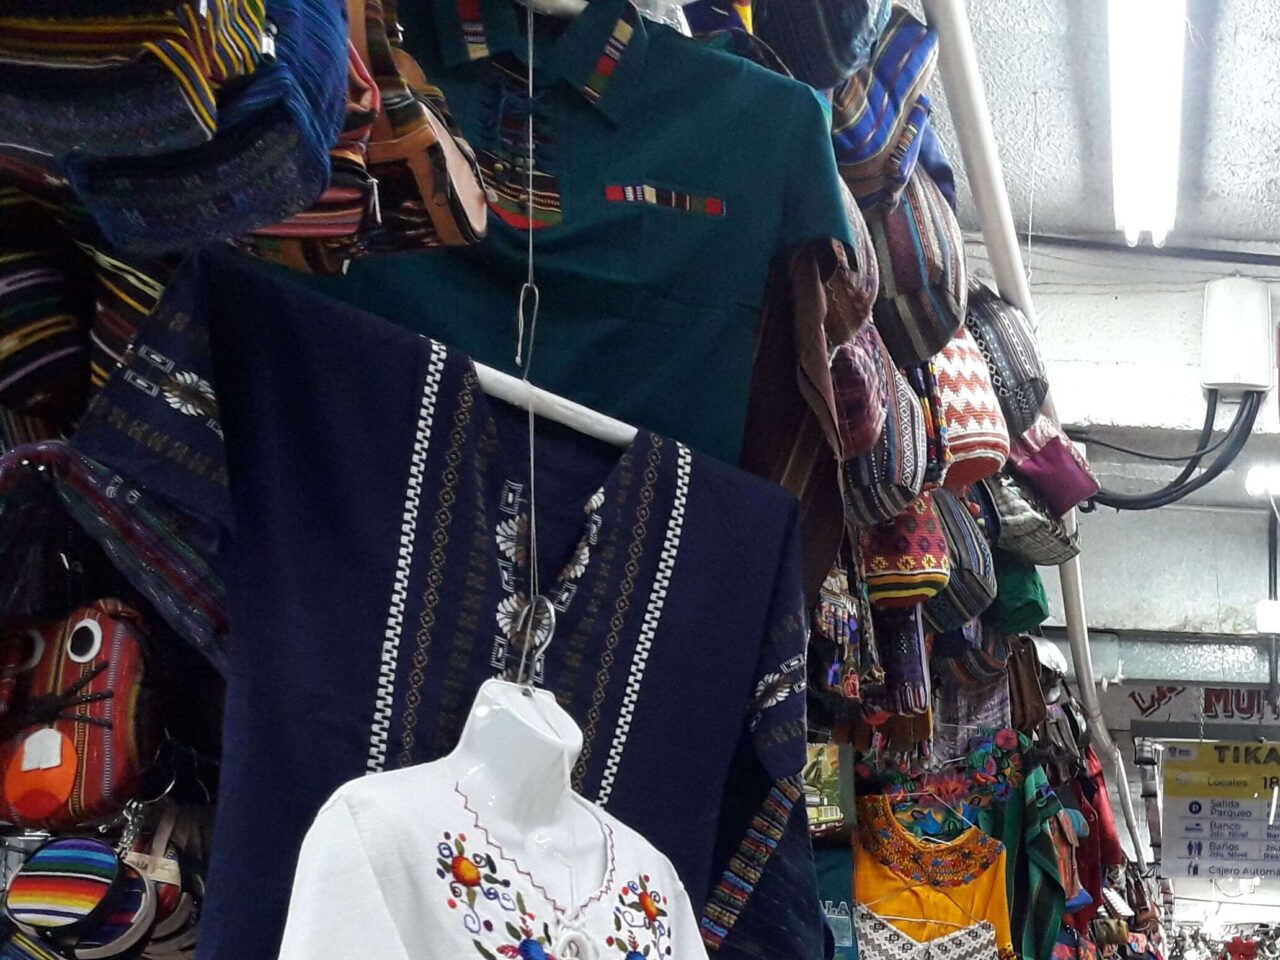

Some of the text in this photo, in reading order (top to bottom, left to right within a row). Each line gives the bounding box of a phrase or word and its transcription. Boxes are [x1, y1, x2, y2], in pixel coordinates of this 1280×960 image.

[1208, 778, 1248, 787] Locales
[1210, 799, 1240, 808] Salida
[1210, 808, 1252, 818] Parqueo
[1210, 821, 1241, 830] Banco
[1209, 842, 1239, 851] Baños
[1208, 866, 1240, 876] Cajero
